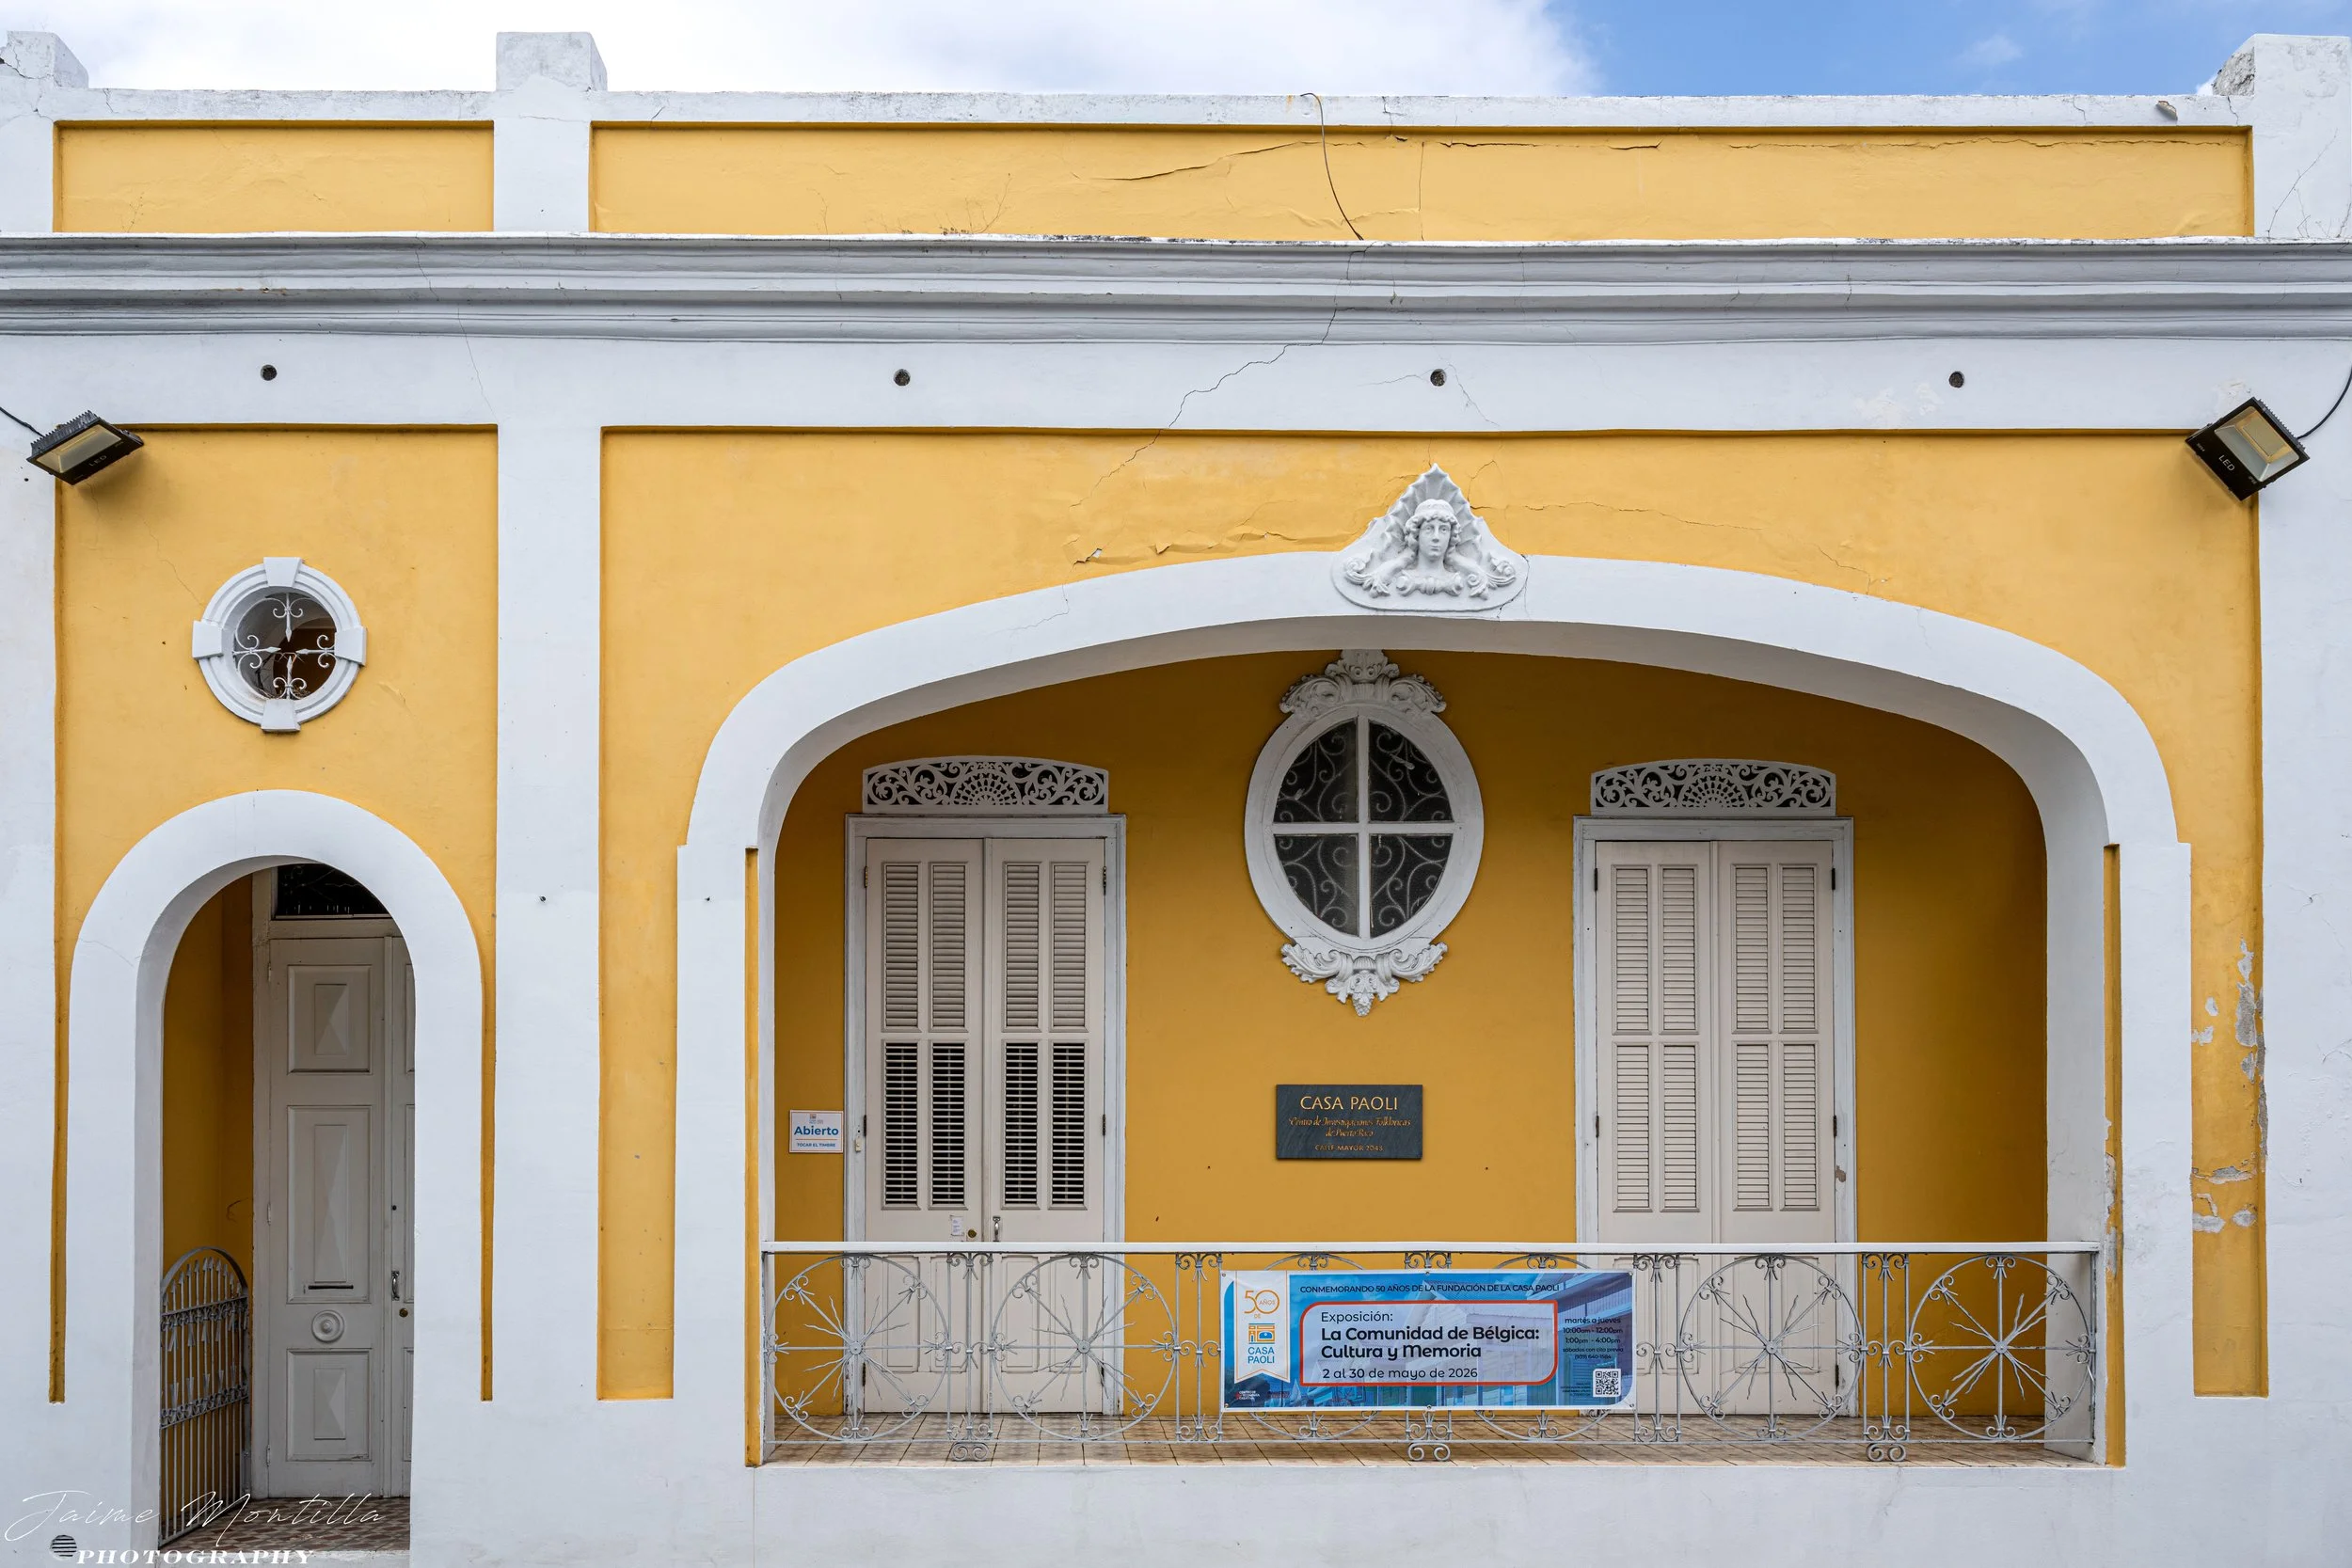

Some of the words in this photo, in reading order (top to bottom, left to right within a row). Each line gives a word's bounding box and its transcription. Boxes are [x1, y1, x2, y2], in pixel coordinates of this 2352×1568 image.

[88, 455, 107, 467] LED
[2218, 455, 2235, 471] LED
[1300, 1097, 1343, 1110] CASA
[1351, 1097, 1397, 1110] PAOLI
[1289, 1117, 1311, 1126] Centro
[1313, 1116, 1321, 1125] de
[794, 1126, 839, 1135] Abierto
[1244, 1290, 1279, 1314] 50
[1322, 1311, 1392, 1323] Exposición:
[1322, 1328, 1341, 1340] La
[1345, 1326, 1443, 1339] Comunidad
[1448, 1326, 1468, 1339] de
[1473, 1325, 1539, 1342] Bélgica:
[1322, 1345, 1382, 1358] Cultura
[1388, 1347, 1397, 1361] y
[1404, 1343, 1481, 1357] Memoria
[1323, 1369, 1330, 1378] 2
[1334, 1369, 1346, 1378] al
[1349, 1369, 1364, 1378] 30
[1369, 1368, 1384, 1378] de
[1389, 1370, 1425, 1380] mayo
[1430, 1368, 1445, 1377] de
[1449, 1368, 1477, 1377] 2026
